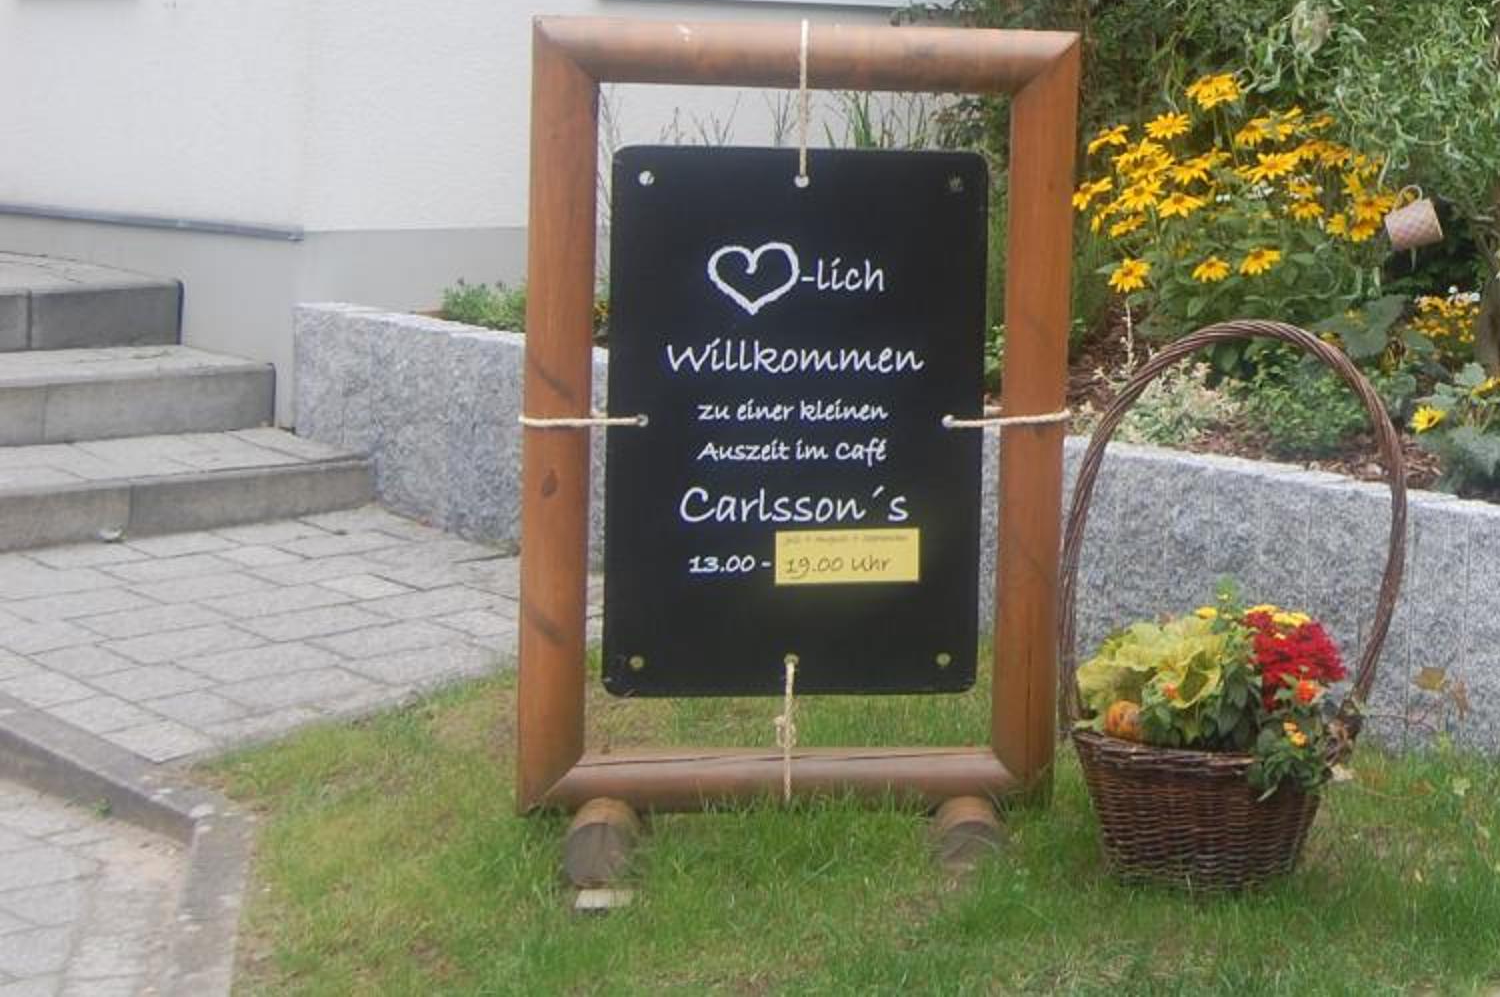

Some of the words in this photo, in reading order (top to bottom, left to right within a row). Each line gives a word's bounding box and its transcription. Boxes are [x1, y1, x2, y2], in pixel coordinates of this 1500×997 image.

[666, 337, 925, 374] Willkommen
[697, 403, 731, 421] zu
[736, 398, 795, 421] einer
[799, 399, 889, 421] kleinen
[696, 439, 790, 462] Auszeit
[795, 438, 829, 461] im
[835, 437, 888, 468] Café
[688, 555, 756, 574] 13.00
[785, 556, 844, 580] 19.00
[851, 553, 892, 573] Uhr
